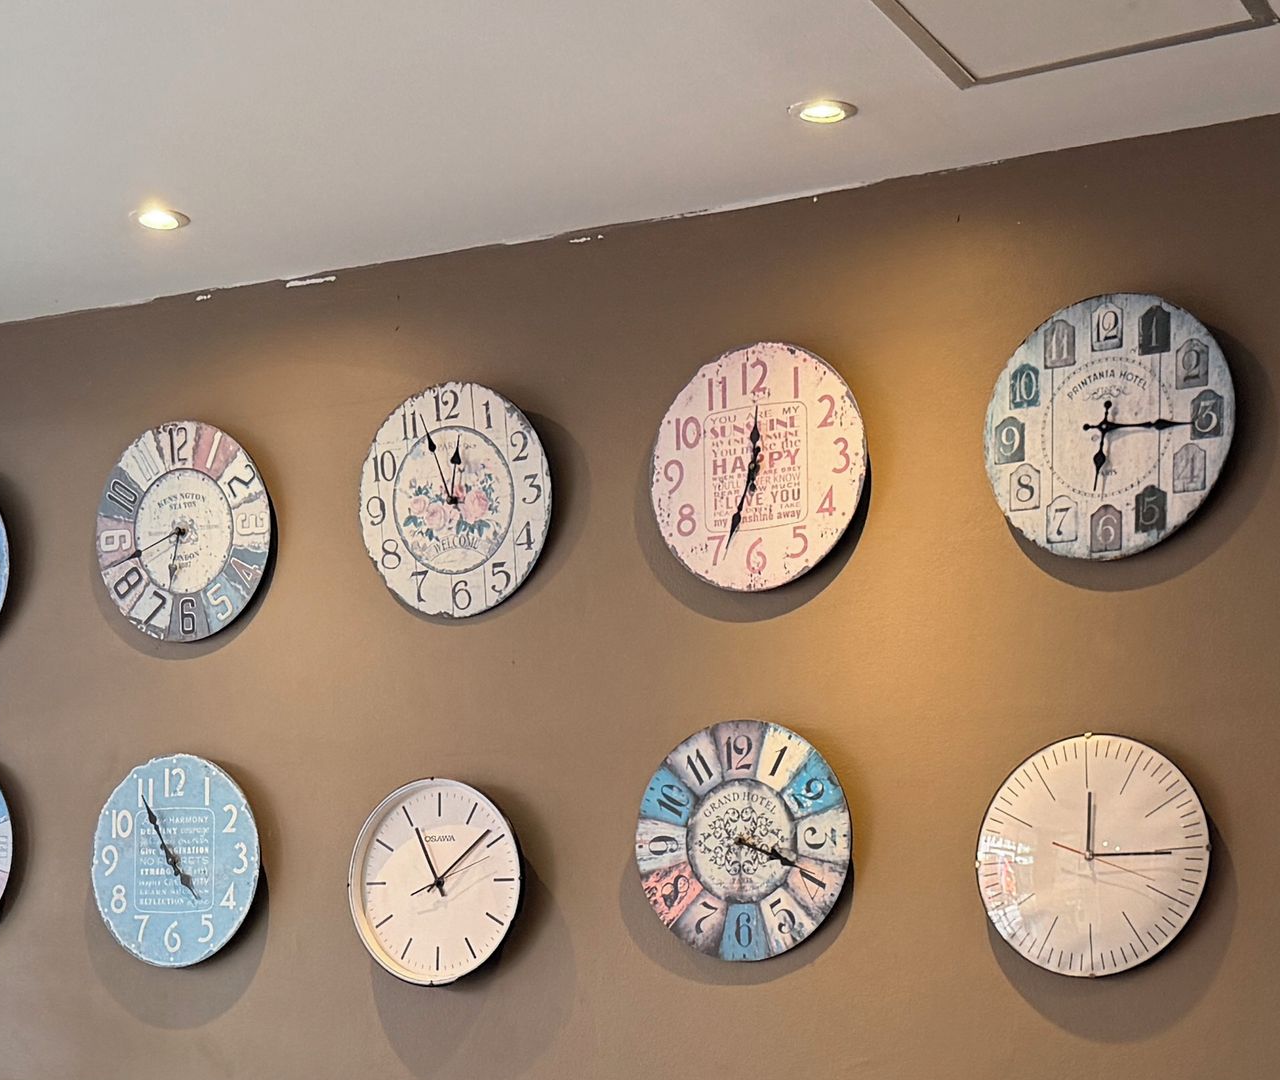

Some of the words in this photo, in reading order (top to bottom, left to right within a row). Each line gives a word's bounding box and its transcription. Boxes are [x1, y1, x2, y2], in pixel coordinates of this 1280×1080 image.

[1096, 310, 1119, 343] 12
[1150, 316, 1158, 348] 1
[1052, 326, 1068, 361] 11
[742, 360, 768, 395] 12
[1181, 350, 1202, 382] 2
[708, 376, 727, 411] 11
[794, 367, 798, 398] 1
[1012, 371, 1038, 404] 10
[1067, 369, 1116, 400] PRINTANIA
[1120, 370, 1148, 390] HOTEL
[433, 390, 460, 422] 12
[482, 400, 492, 430] 1
[711, 415, 736, 424] YOU
[782, 406, 800, 415] MY
[818, 395, 835, 428] 2
[1194, 401, 1217, 434] 3
[402, 410, 418, 440] 11
[676, 416, 701, 450] 10
[169, 426, 188, 464] 12
[206, 431, 222, 470] 1
[510, 430, 528, 462] 2
[832, 437, 850, 474] 3
[1000, 426, 1020, 456] 9
[132, 440, 160, 481] 11
[373, 450, 396, 482] 10
[712, 448, 800, 475] HAPPY
[1176, 452, 1199, 484] 4
[228, 464, 256, 498] 2
[522, 474, 542, 504] 3
[664, 460, 684, 495] 9
[774, 473, 800, 482] KNOW
[1016, 474, 1035, 502] 8
[106, 479, 138, 514] 10
[366, 496, 386, 526] 9
[771, 488, 800, 503] YOU
[816, 486, 836, 514] 4
[1140, 496, 1158, 526] 5
[236, 512, 269, 536] 3
[677, 504, 696, 536] 8
[714, 518, 728, 528] my
[777, 510, 801, 519] away
[1054, 507, 1071, 536] 7
[1096, 514, 1118, 544] 6
[100, 530, 132, 552] 9
[434, 534, 478, 554] WELCOME
[516, 521, 536, 550] 4
[707, 535, 726, 566] 7
[788, 526, 808, 559] 5
[382, 538, 401, 569] 8
[746, 538, 767, 574] 6
[114, 566, 142, 599] 8
[230, 557, 259, 588] 4
[410, 570, 428, 602] 7
[492, 561, 510, 593] 5
[142, 590, 166, 625] 7
[207, 583, 234, 620] 5
[452, 580, 472, 610] 6
[179, 597, 196, 634] 6
[686, 748, 714, 786] 11
[724, 735, 752, 772] 12
[768, 746, 788, 776] 1
[138, 778, 153, 807] 11
[164, 768, 186, 797] 12
[204, 777, 210, 806] 1
[792, 778, 825, 808] 2
[656, 784, 690, 818] 10
[704, 792, 740, 818] GRAND
[742, 792, 776, 815] HOTEL
[112, 810, 133, 838] 10
[169, 816, 209, 824] HARMONY
[222, 804, 238, 833] 2
[648, 836, 679, 856] 9
[804, 826, 837, 850] 3
[102, 845, 118, 876] 9
[233, 842, 248, 874] 3
[110, 885, 126, 913] 8
[220, 882, 236, 910] 4
[660, 874, 690, 909] 8
[799, 869, 826, 900] 4
[134, 915, 150, 942] 7
[198, 914, 213, 943] 5
[696, 902, 718, 935] 7
[734, 912, 752, 947] 6
[770, 898, 796, 934] 5
[164, 920, 182, 953] 6
